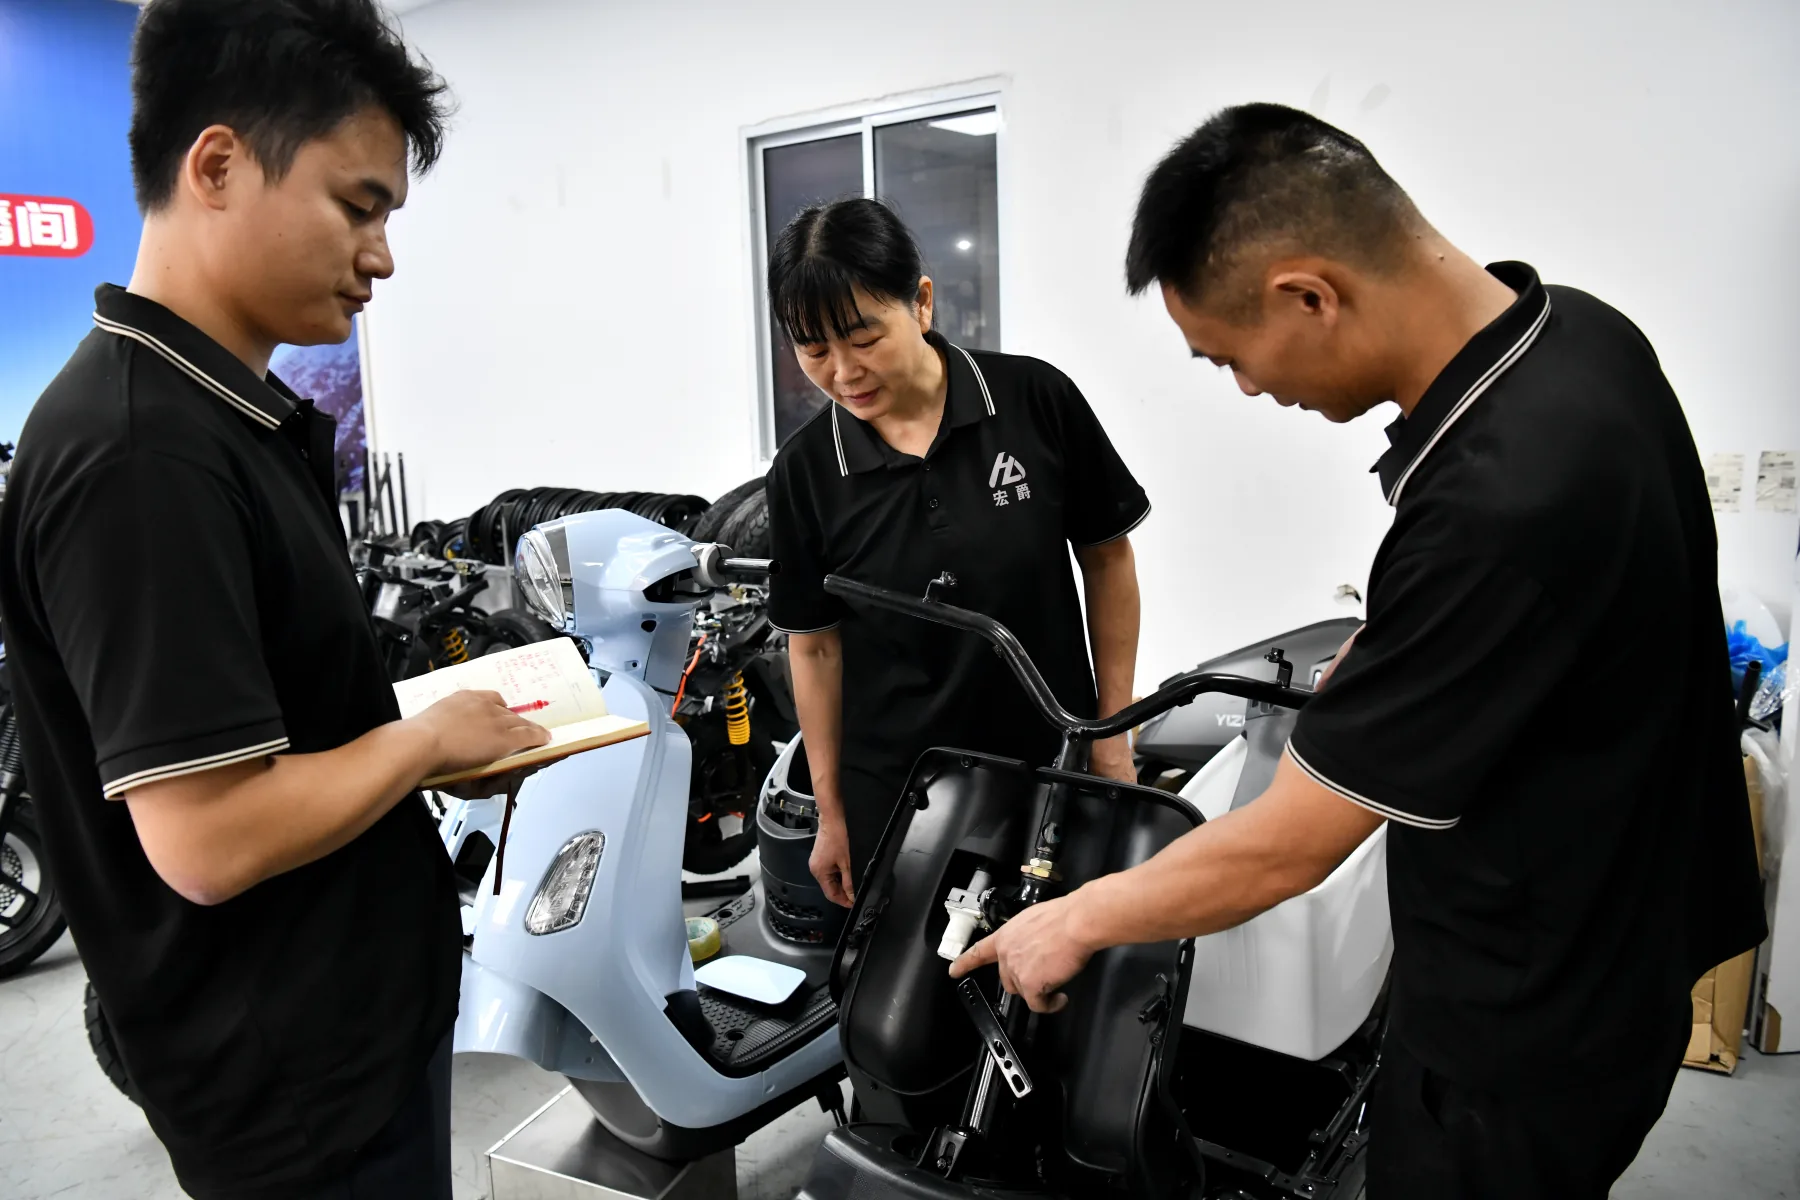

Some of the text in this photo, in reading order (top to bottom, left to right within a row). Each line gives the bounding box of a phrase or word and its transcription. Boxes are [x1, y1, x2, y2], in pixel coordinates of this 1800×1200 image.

[0, 199, 79, 250] 间
[992, 482, 1031, 507] 宏爵
[1215, 713, 1246, 727] YIZ
